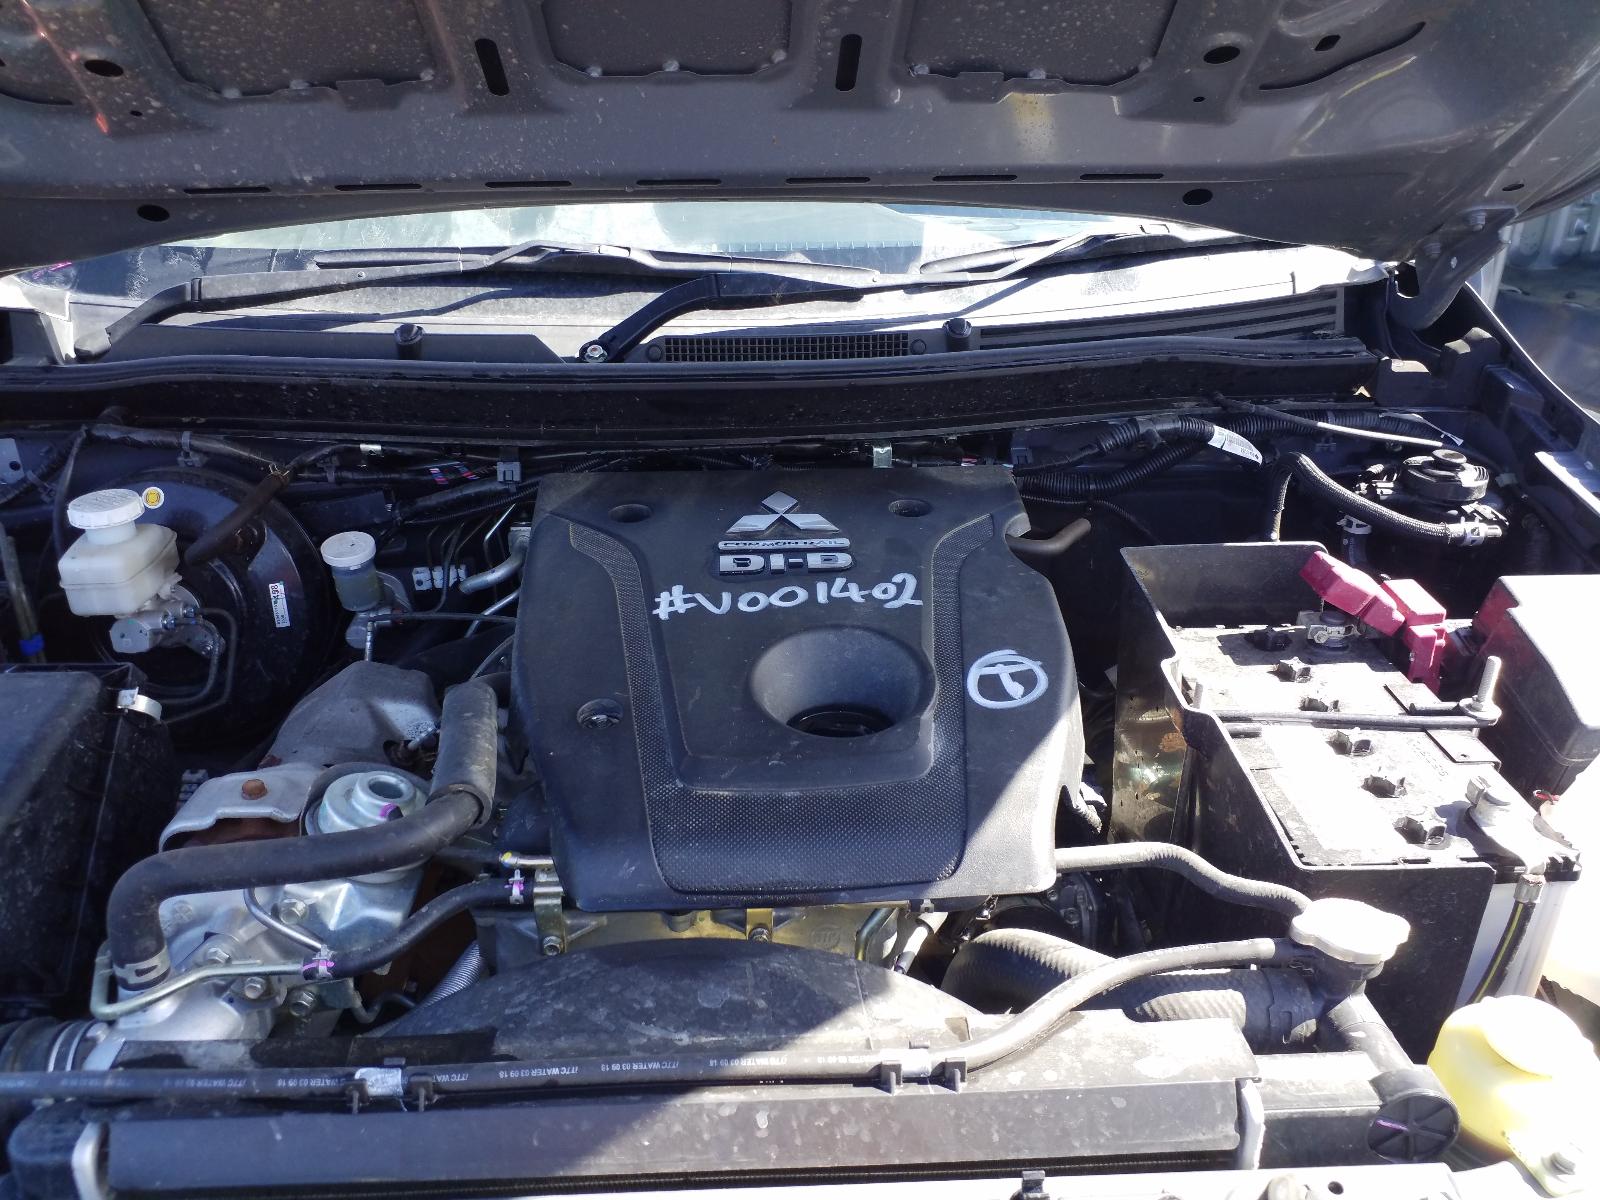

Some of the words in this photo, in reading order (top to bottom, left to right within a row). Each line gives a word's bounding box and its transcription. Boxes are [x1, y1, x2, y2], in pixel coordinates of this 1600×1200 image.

[719, 552, 852, 575] DI-D
[622, 1062, 631, 1070] 03
[631, 1061, 661, 1070] WATER
[499, 1070, 508, 1079] 18
[510, 1069, 519, 1078] 09
[520, 1069, 530, 1077] 03
[531, 1067, 560, 1076] WATER
[310, 1078, 338, 1087] WATER
[432, 1074, 450, 1083] WAT
